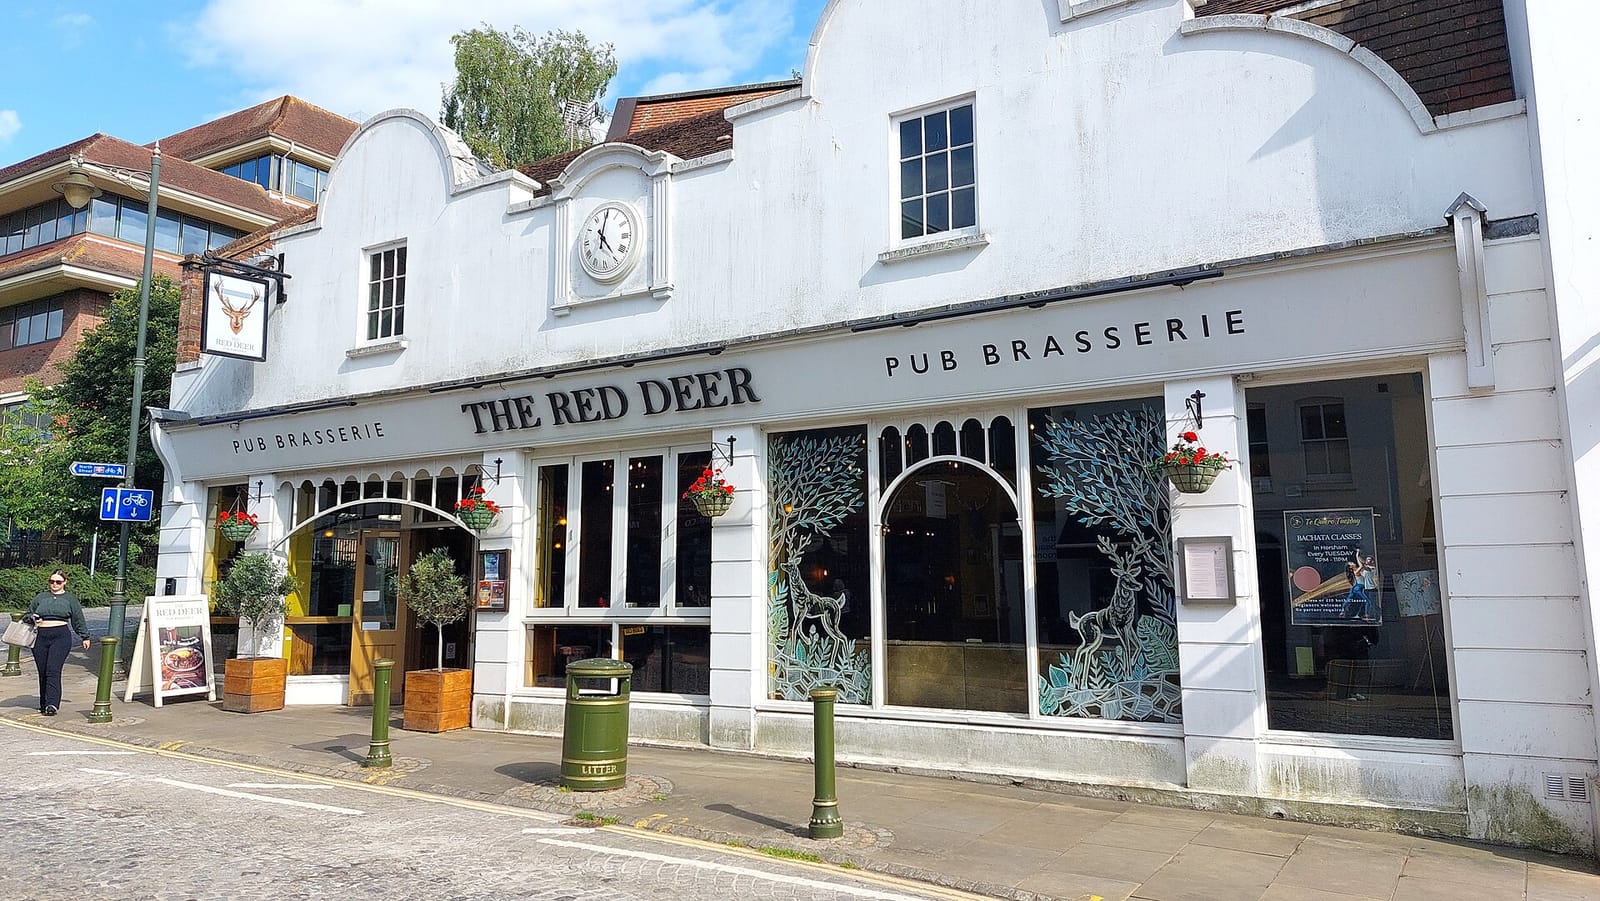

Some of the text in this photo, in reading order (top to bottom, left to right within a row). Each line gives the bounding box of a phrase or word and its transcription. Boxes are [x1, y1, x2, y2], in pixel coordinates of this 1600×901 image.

[885, 310, 1245, 376] PUB BRASSERIE
[461, 367, 762, 434] THE RED DEER
[232, 422, 384, 454] PUB BRASSERIE
[156, 607, 202, 616] RED DEER
[582, 765, 618, 774] LITTER
